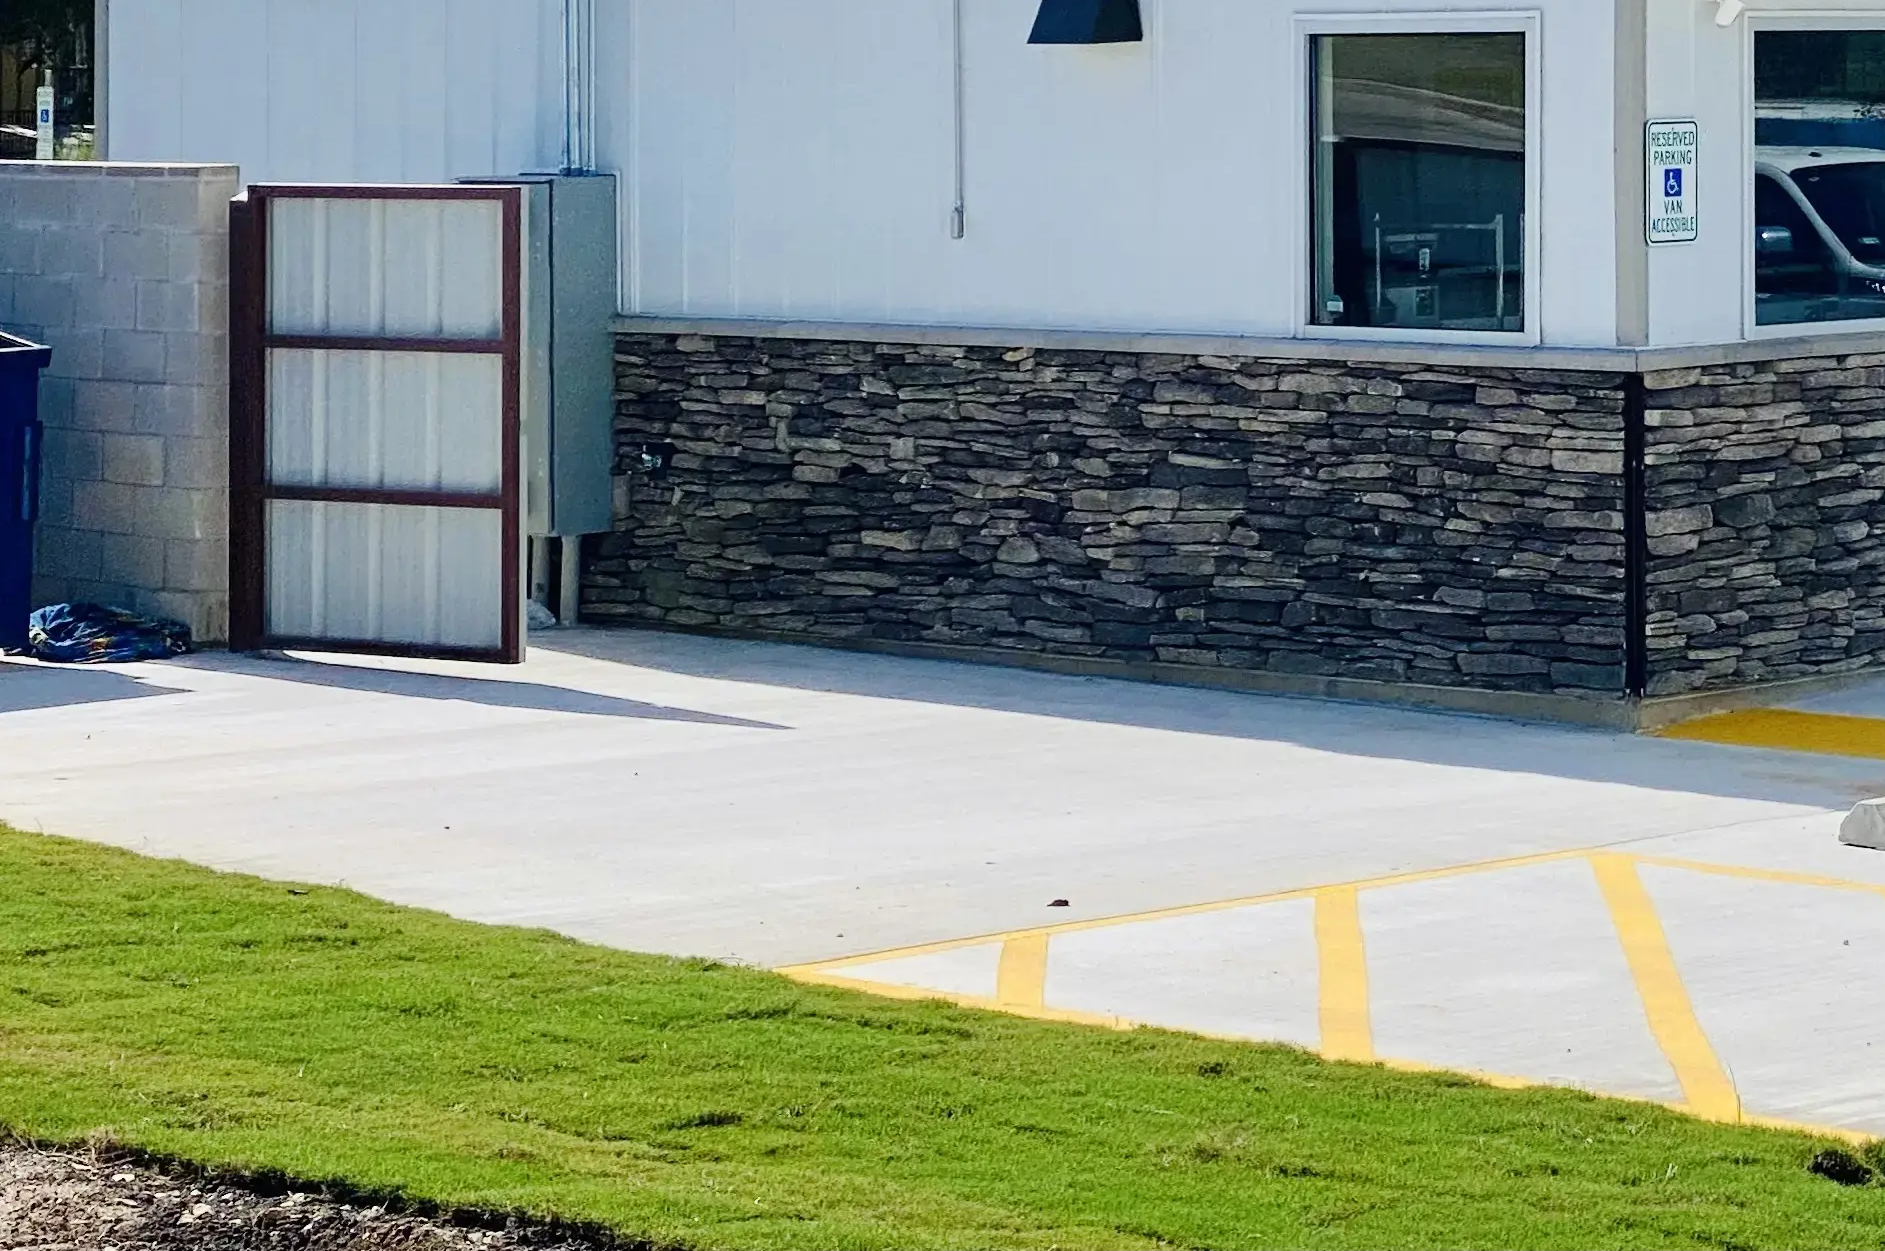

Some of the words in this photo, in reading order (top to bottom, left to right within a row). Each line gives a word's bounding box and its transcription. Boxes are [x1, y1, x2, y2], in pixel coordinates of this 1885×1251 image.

[1651, 131, 1695, 147] RESERVED
[1653, 150, 1692, 165] PARKING
[1664, 199, 1683, 215] VAN
[1652, 216, 1695, 233] ACCESSIBLE
